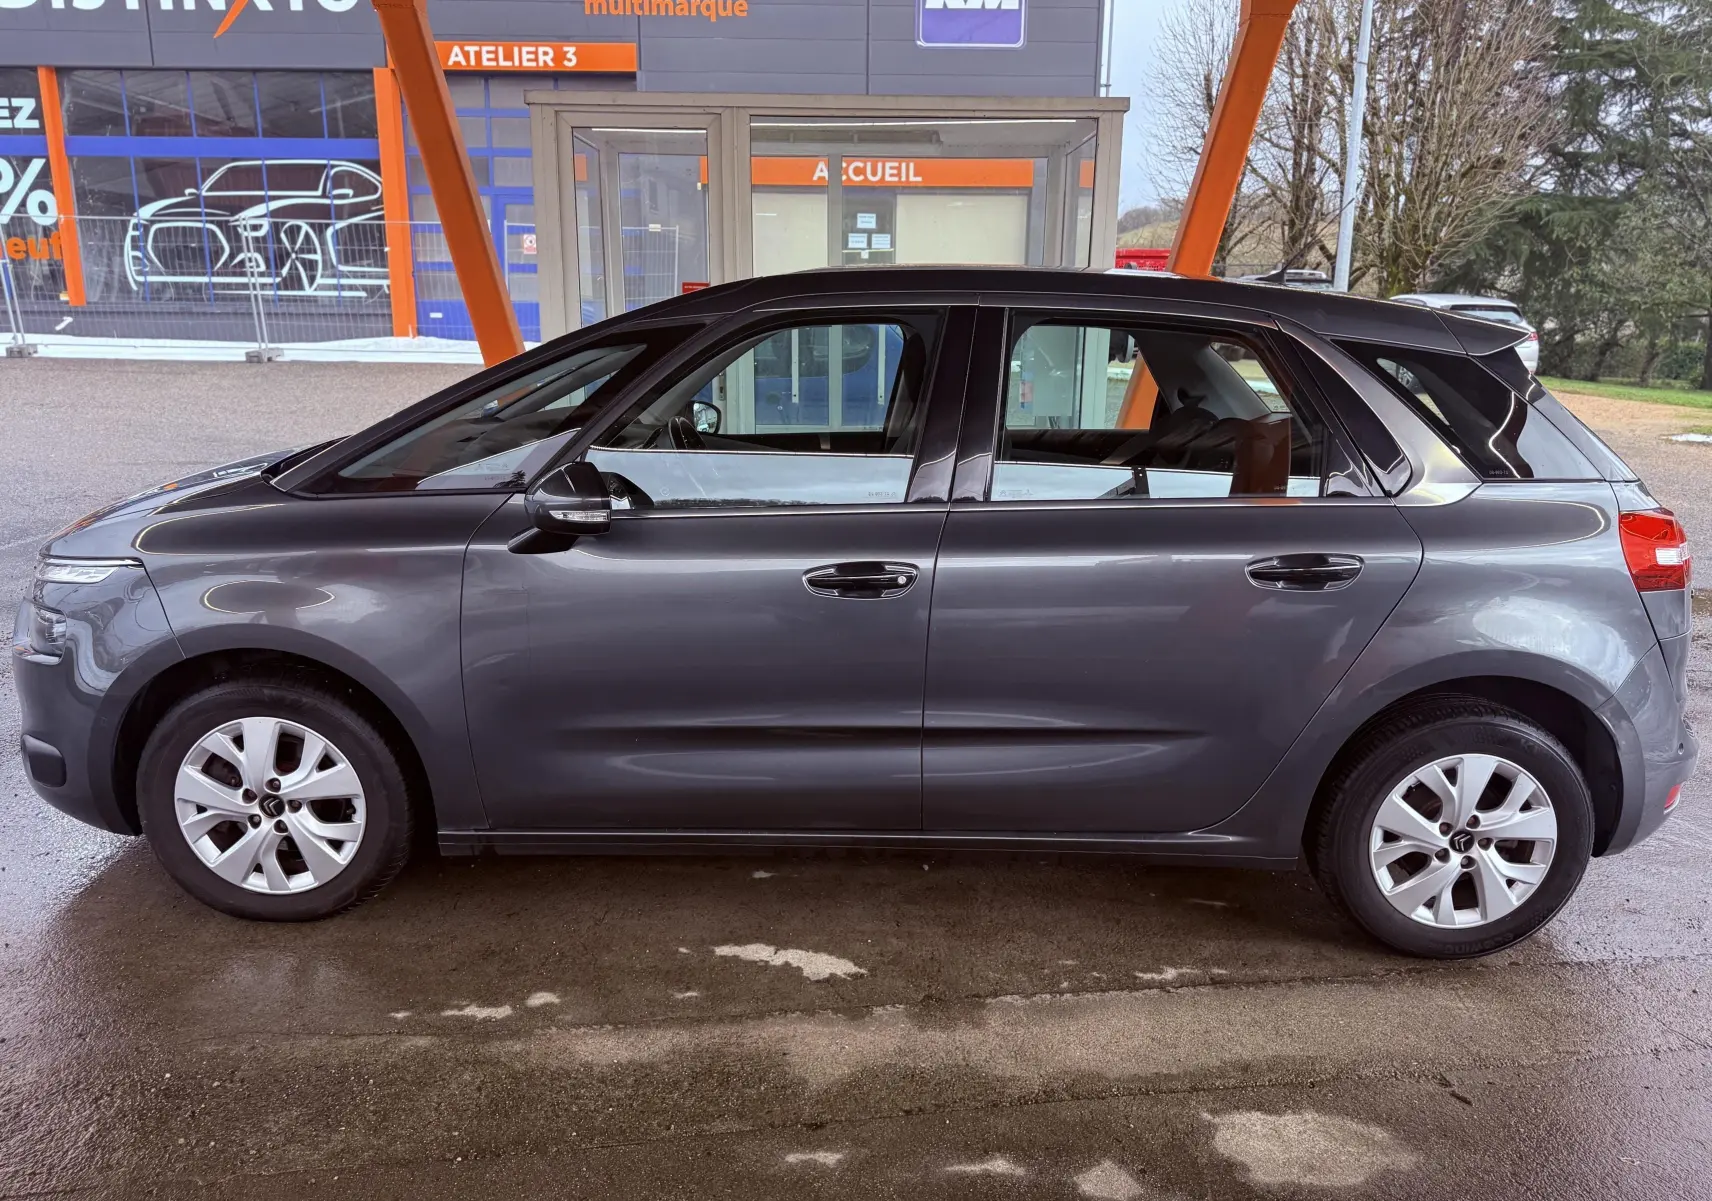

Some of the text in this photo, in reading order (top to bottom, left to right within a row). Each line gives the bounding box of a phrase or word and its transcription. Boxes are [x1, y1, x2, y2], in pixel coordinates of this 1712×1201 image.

[584, 0, 749, 22] multimarque
[448, 45, 577, 67] ATELIER 3
[0, 231, 63, 260] euf
